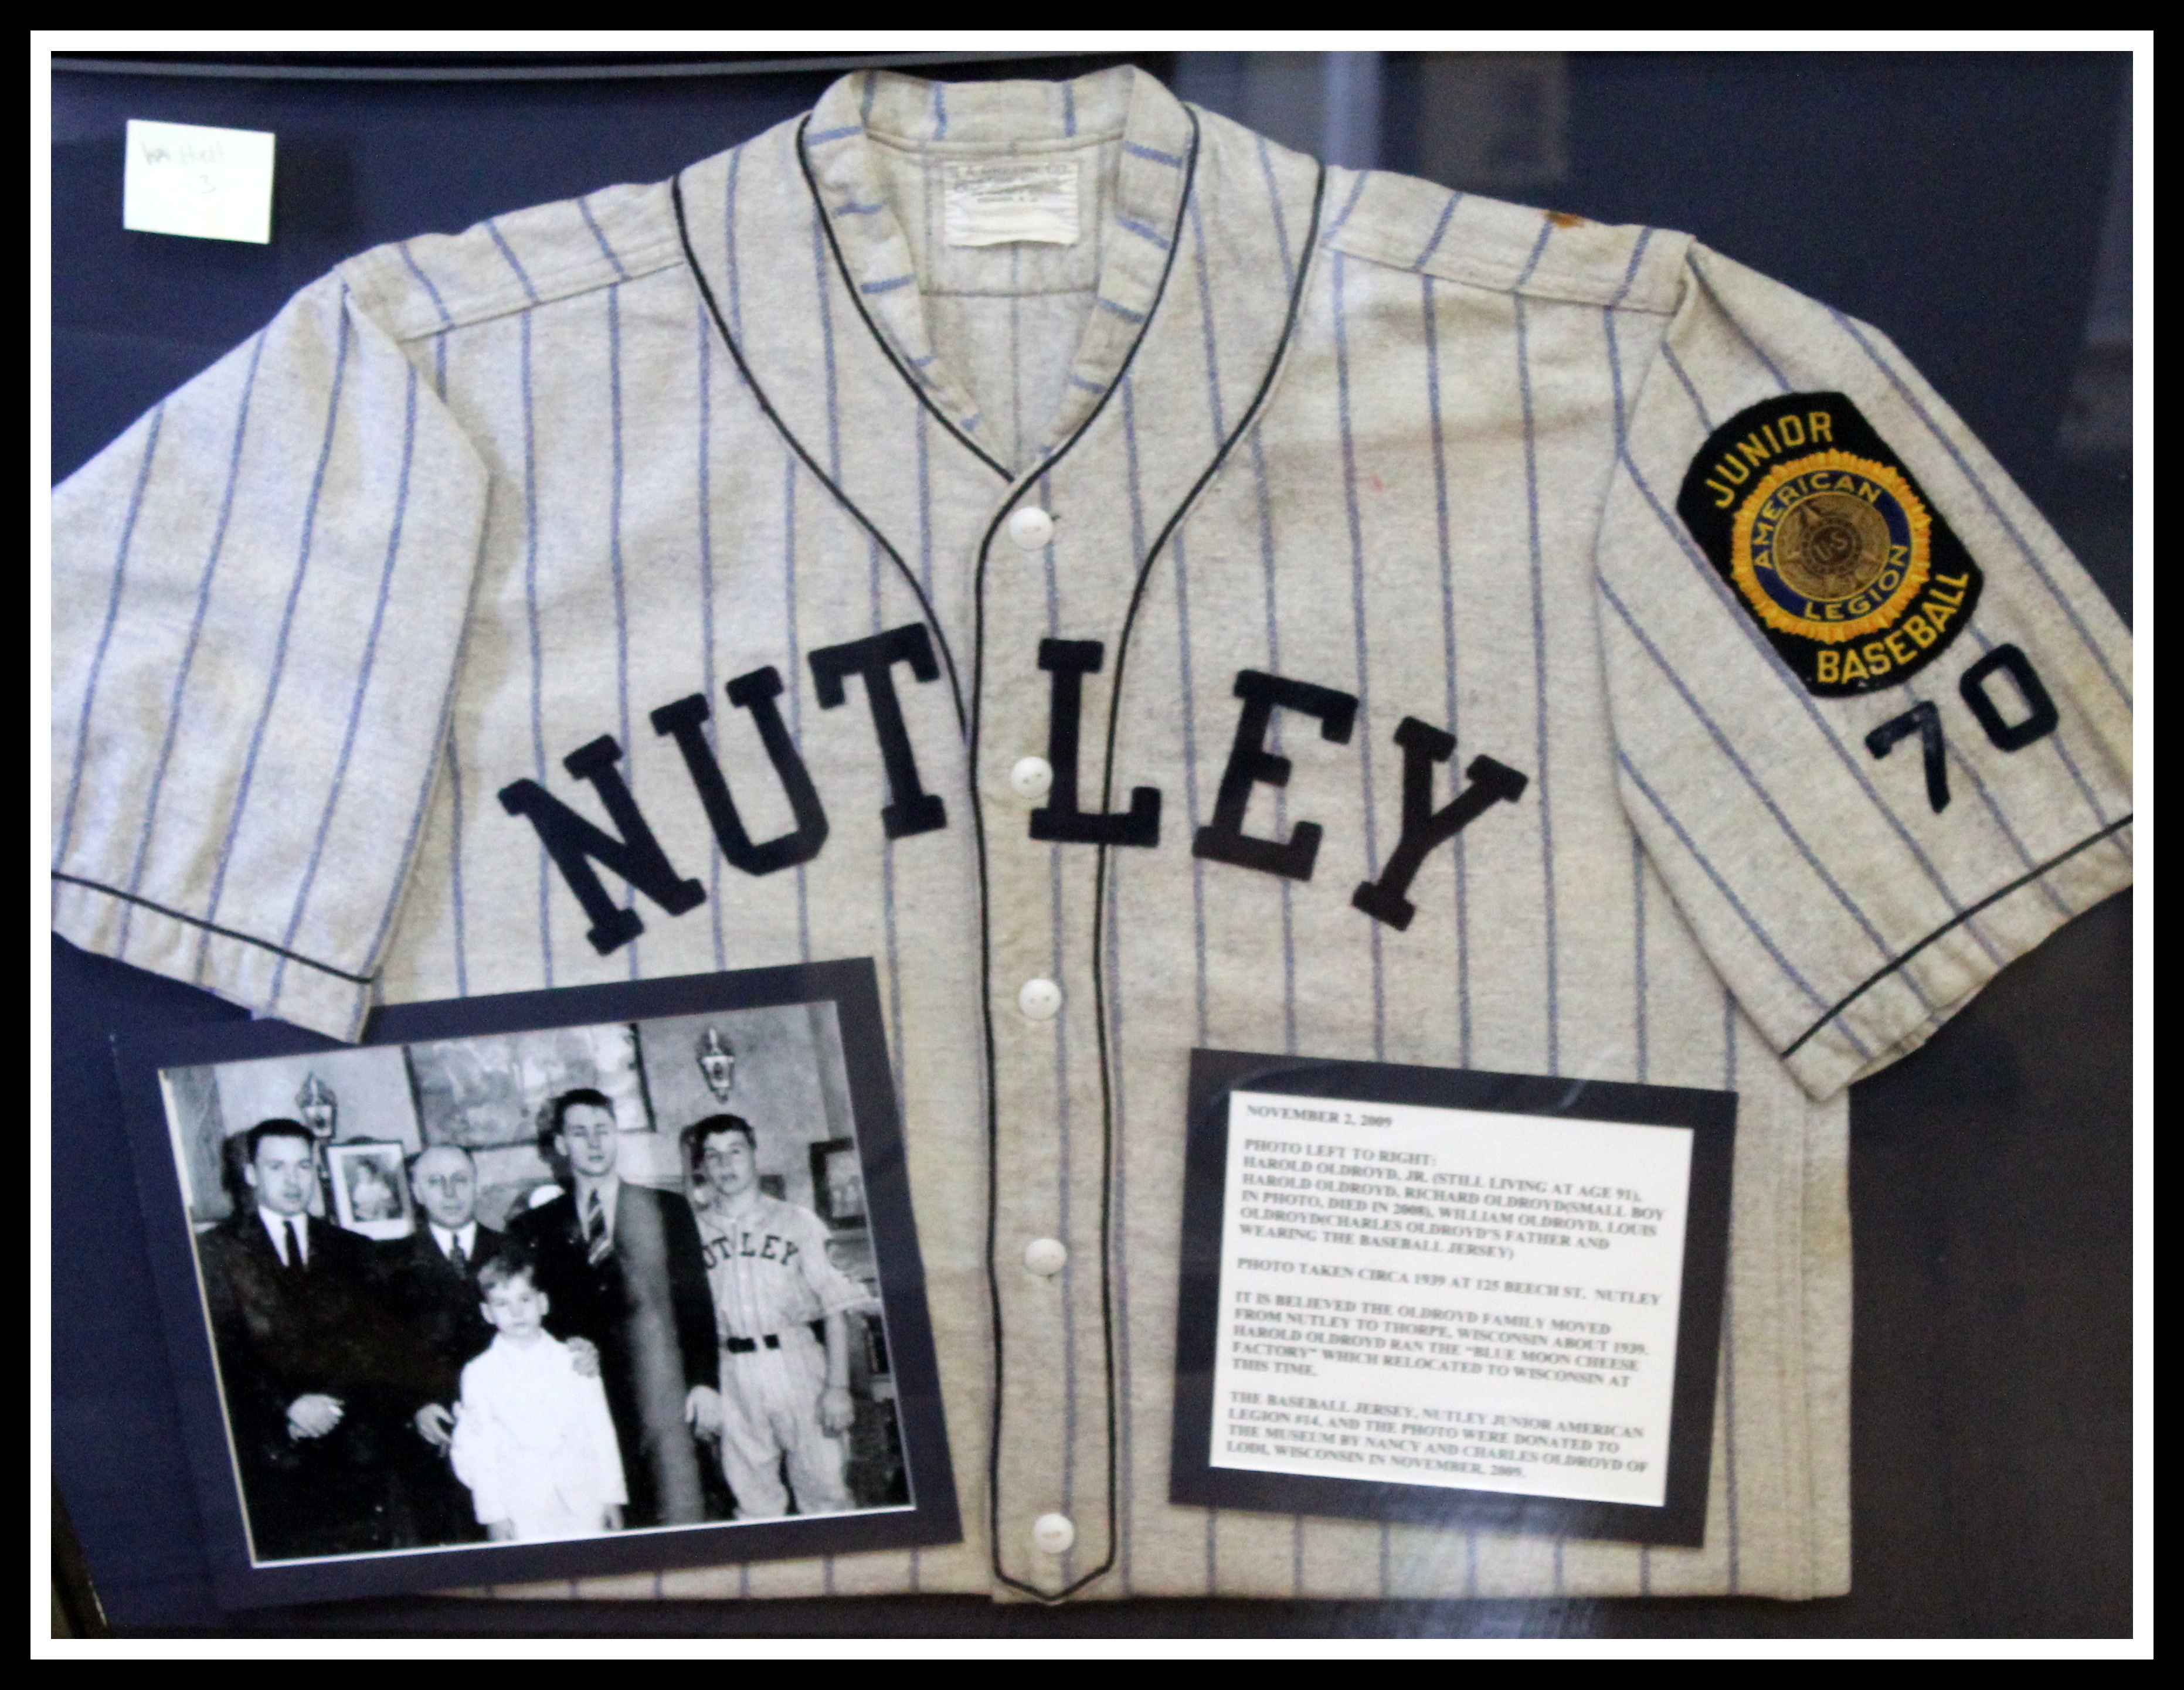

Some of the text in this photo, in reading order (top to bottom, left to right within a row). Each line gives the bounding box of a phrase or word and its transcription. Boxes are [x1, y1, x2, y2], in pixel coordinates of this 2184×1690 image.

[1705, 411, 1834, 509] JUNIOR
[1753, 472, 1881, 570] AMERICAN
[1804, 545, 1908, 621] LEGION
[1817, 572, 1970, 685] BASEBALL
[1864, 643, 2059, 814] 70
[498, 622, 1529, 956] NUTLEY
[1246, 1104, 1393, 1128] NOVEMBER 2, 2009
[1244, 1138, 1436, 1166] PHOTO LEFT TO RIGHT:
[1241, 1173, 1313, 1190] HAROLD
[1314, 1179, 1401, 1198] OLDROYD,
[1404, 1186, 1480, 1205] RICHARD
[1630, 1206, 1665, 1220] BOY
[1242, 1156, 1313, 1173] HAROLD
[1315, 1162, 1402, 1180] OLDROYD,
[1404, 1169, 1429, 1183] JR.
[1431, 1172, 1485, 1188] (STILL
[1488, 1177, 1547, 1193] LIVING
[1552, 1182, 1572, 1195] AT
[1578, 1185, 1612, 1199] AGE
[1241, 1189, 1259, 1202] IN
[1262, 1192, 1324, 1208] PHOTO,
[1327, 1197, 1368, 1212] DIED
[1371, 1201, 1389, 1213] IN
[1438, 1207, 1514, 1224] WILLIAM
[1517, 1214, 1603, 1232] OLDROYD,
[1606, 1222, 1657, 1237] LOUIS
[703, 1232, 800, 1269] UTLEY
[1238, 1223, 1514, 1259] WEARING THE BASEBALL JERSEY)
[1504, 1230, 1571, 1246] FATHER
[1575, 1236, 1611, 1250] AND
[1237, 1257, 1660, 1305] PHOTO TAKEN CIRCA 1939 AT 125 BEECH ST. NUTLEY
[1234, 1308, 1282, 1322] FROM
[1285, 1312, 1350, 1328] NUTLEY
[1356, 1318, 1380, 1331] TO
[1383, 1321, 1453, 1338] THORPE,
[1456, 1328, 1548, 1346] WISCONSIN
[1553, 1336, 1608, 1352] ABOUT
[1235, 1291, 1612, 1335] IT IS BELIEVED THE OLDROYD FAMILY MOVED
[1232, 1325, 1303, 1341] HAROLD
[1305, 1331, 1387, 1349] OLDROYD
[1389, 1338, 1424, 1352] RAN
[1428, 1342, 1460, 1355] THE
[1520, 1350, 1571, 1365] MOON
[1574, 1355, 1639, 1371] CHEESE
[1232, 1358, 1318, 1376] THIS TIME.
[1320, 1349, 1380, 1365] WHICH
[1381, 1355, 1483, 1374] RELOCATED
[1487, 1363, 1510, 1376] TO
[1512, 1366, 1605, 1385] WISCONSIN
[1609, 1375, 1630, 1387] AT
[1228, 1408, 1291, 1423] LEGION
[1327, 1416, 1361, 1430] AND
[1364, 1420, 1397, 1433] THE
[1401, 1423, 1459, 1439] PHOTO
[1461, 1429, 1509, 1443] WERE
[1513, 1433, 1593, 1451] DONATED
[1596, 1441, 1621, 1453] TO
[1230, 1391, 1645, 1439] THE BASEBALL JERSEY, NUTLEY JUNIOR AMERICAN
[1225, 1440, 1271, 1455] LODI,
[1273, 1445, 1365, 1463] WISCONSIN
[1368, 1453, 1386, 1465] IN
[1390, 1456, 1487, 1475] NOVEMBER,
[1228, 1424, 1649, 1473] THE MUSEUM BY NANCY AND CHARLES OLDROYD OF
